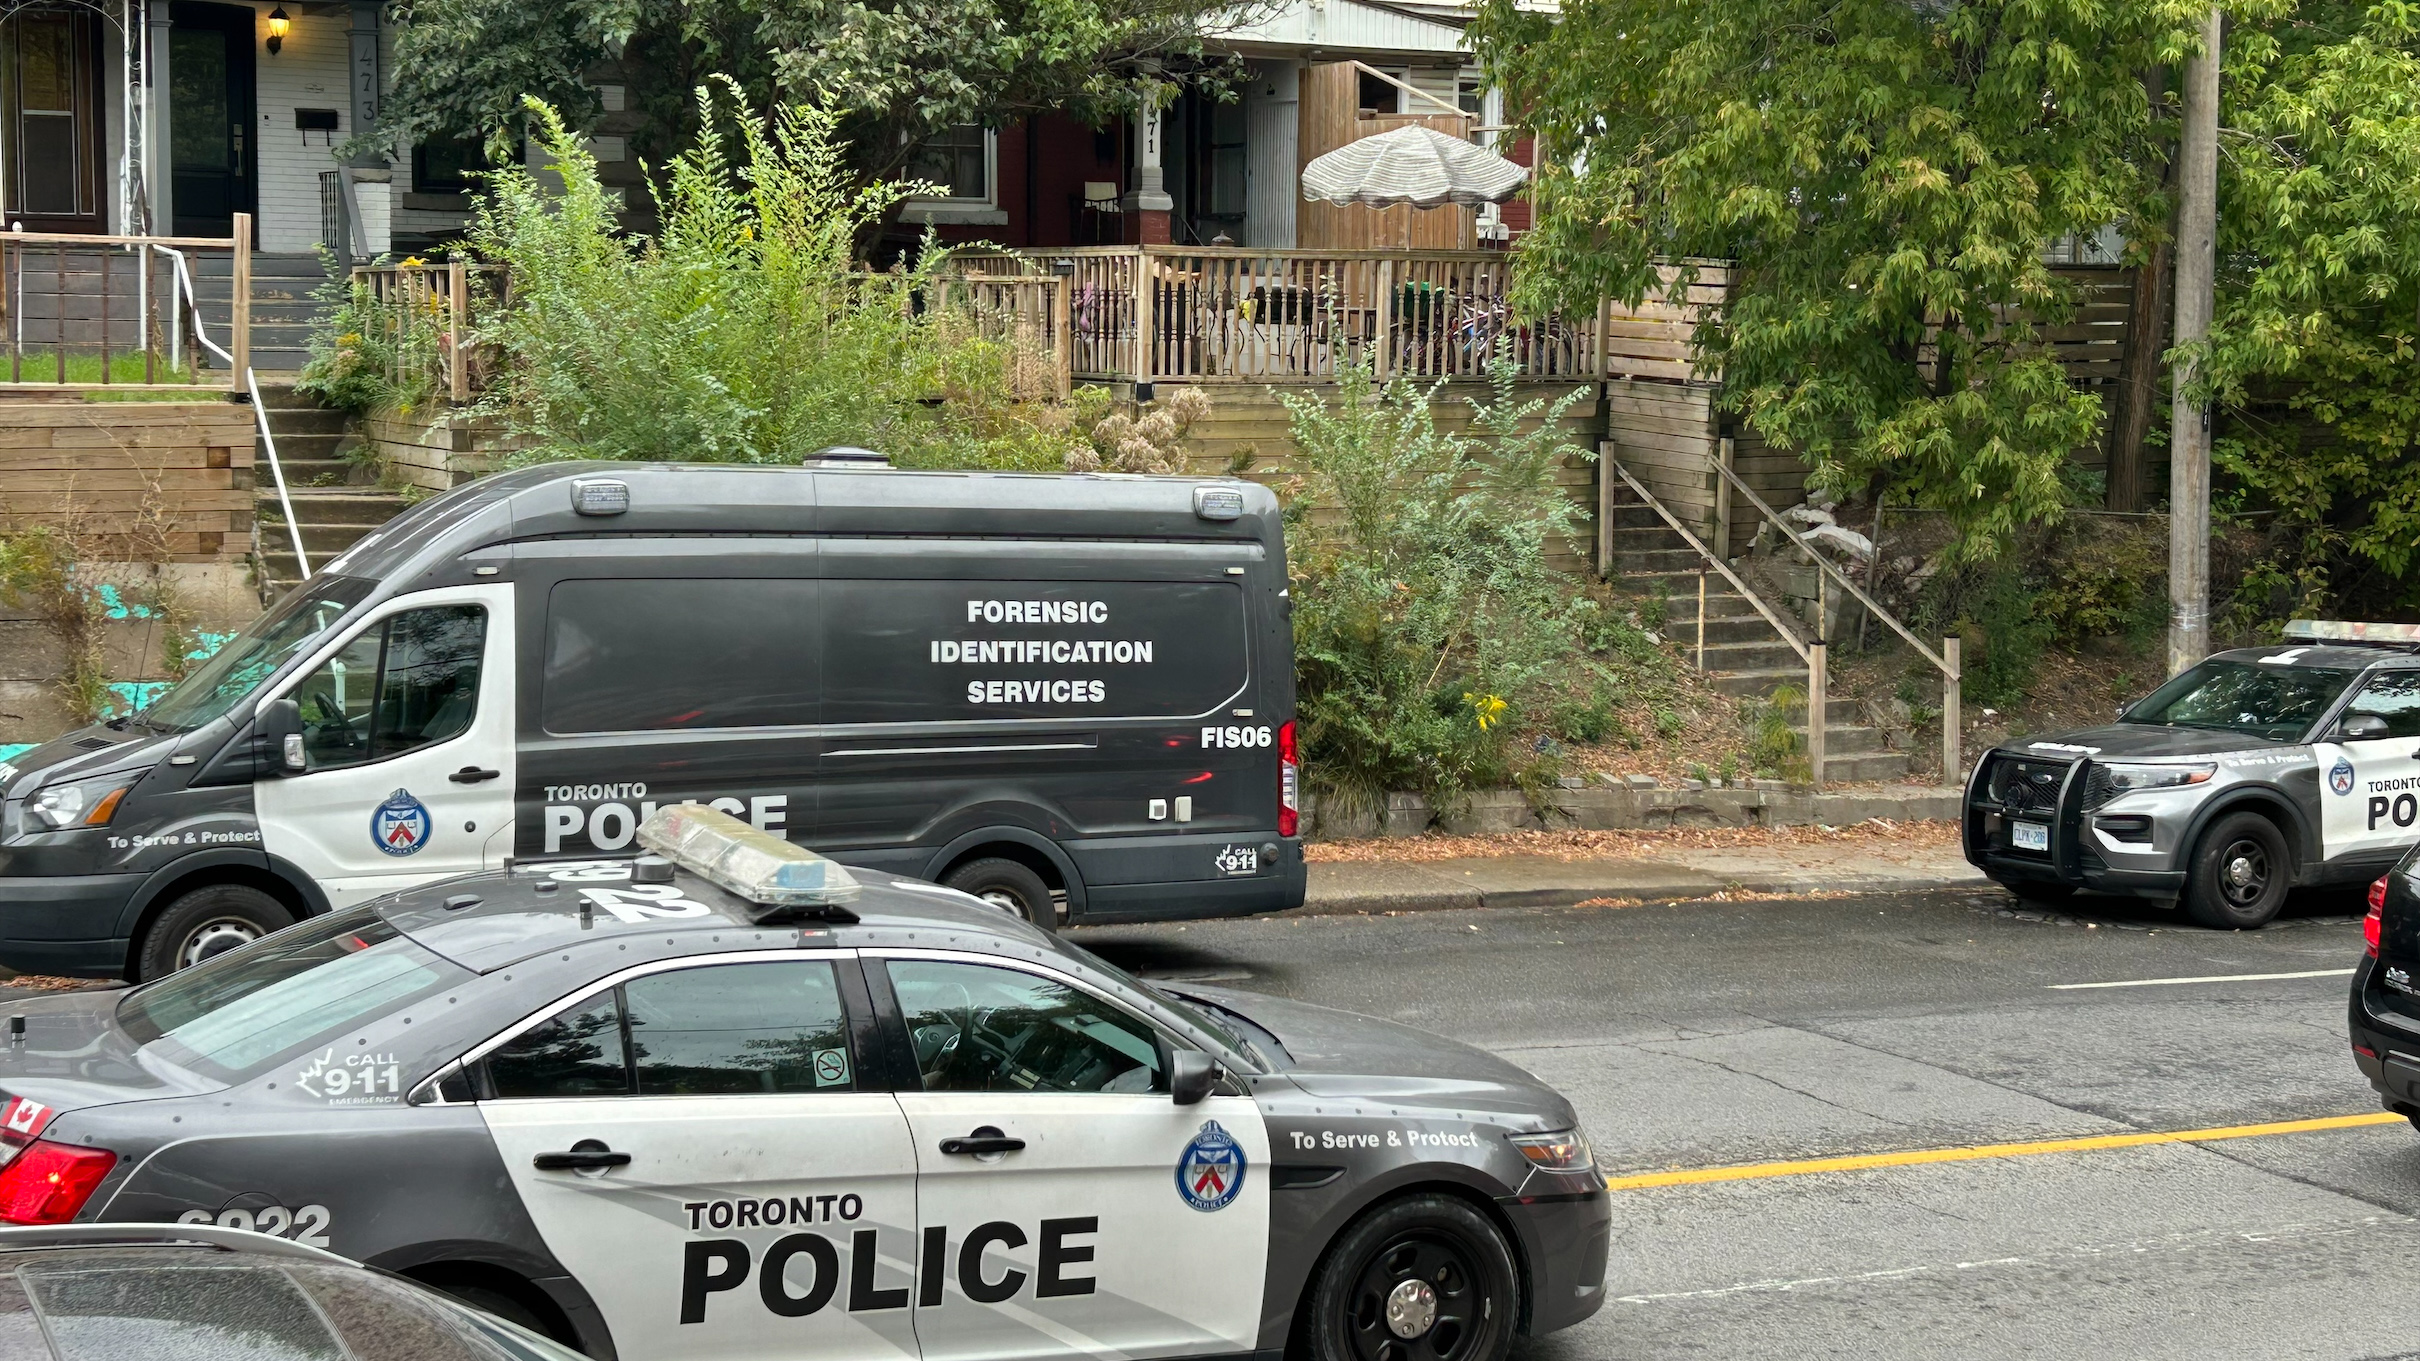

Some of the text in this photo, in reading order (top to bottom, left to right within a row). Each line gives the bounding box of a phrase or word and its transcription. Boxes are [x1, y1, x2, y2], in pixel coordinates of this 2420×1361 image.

[359, 47, 375, 121] 473
[967, 600, 1108, 624] FORENSIC
[930, 640, 1153, 663] IDENTIFICATION
[967, 680, 1106, 704] SERVICES
[1201, 726, 1272, 749] FIS06
[544, 782, 647, 801] TORONTO
[107, 830, 261, 849] To Serve & Protect
[1234, 848, 1257, 856] CALL
[345, 1053, 399, 1066] CALL
[324, 1065, 399, 1095] 9-1-1
[1290, 1130, 1479, 1149] To Serve & Protect
[684, 1193, 863, 1230] TORONTO
[680, 1216, 1099, 1325] POLICE
